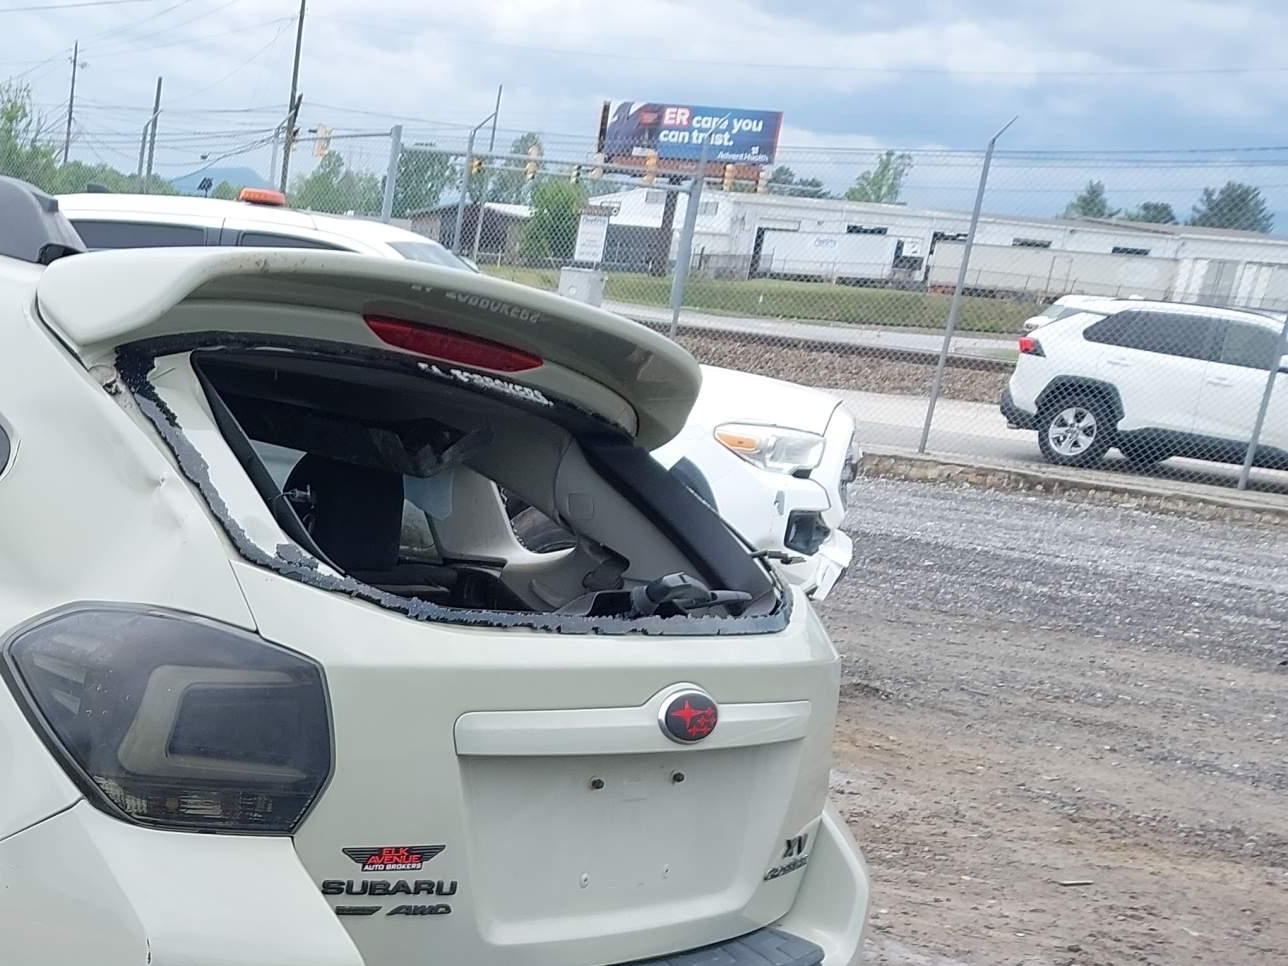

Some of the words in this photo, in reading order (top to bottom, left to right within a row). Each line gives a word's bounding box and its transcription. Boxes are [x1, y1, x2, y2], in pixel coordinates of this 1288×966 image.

[664, 107, 690, 126] ER
[692, 115, 729, 130] care
[732, 119, 763, 134] you
[659, 129, 689, 144] can
[382, 847, 409, 856] ELK
[367, 855, 421, 864] AVENUE
[386, 862, 422, 870] BROKERS
[321, 879, 458, 896] SUBARU
[385, 904, 452, 916] AWD
